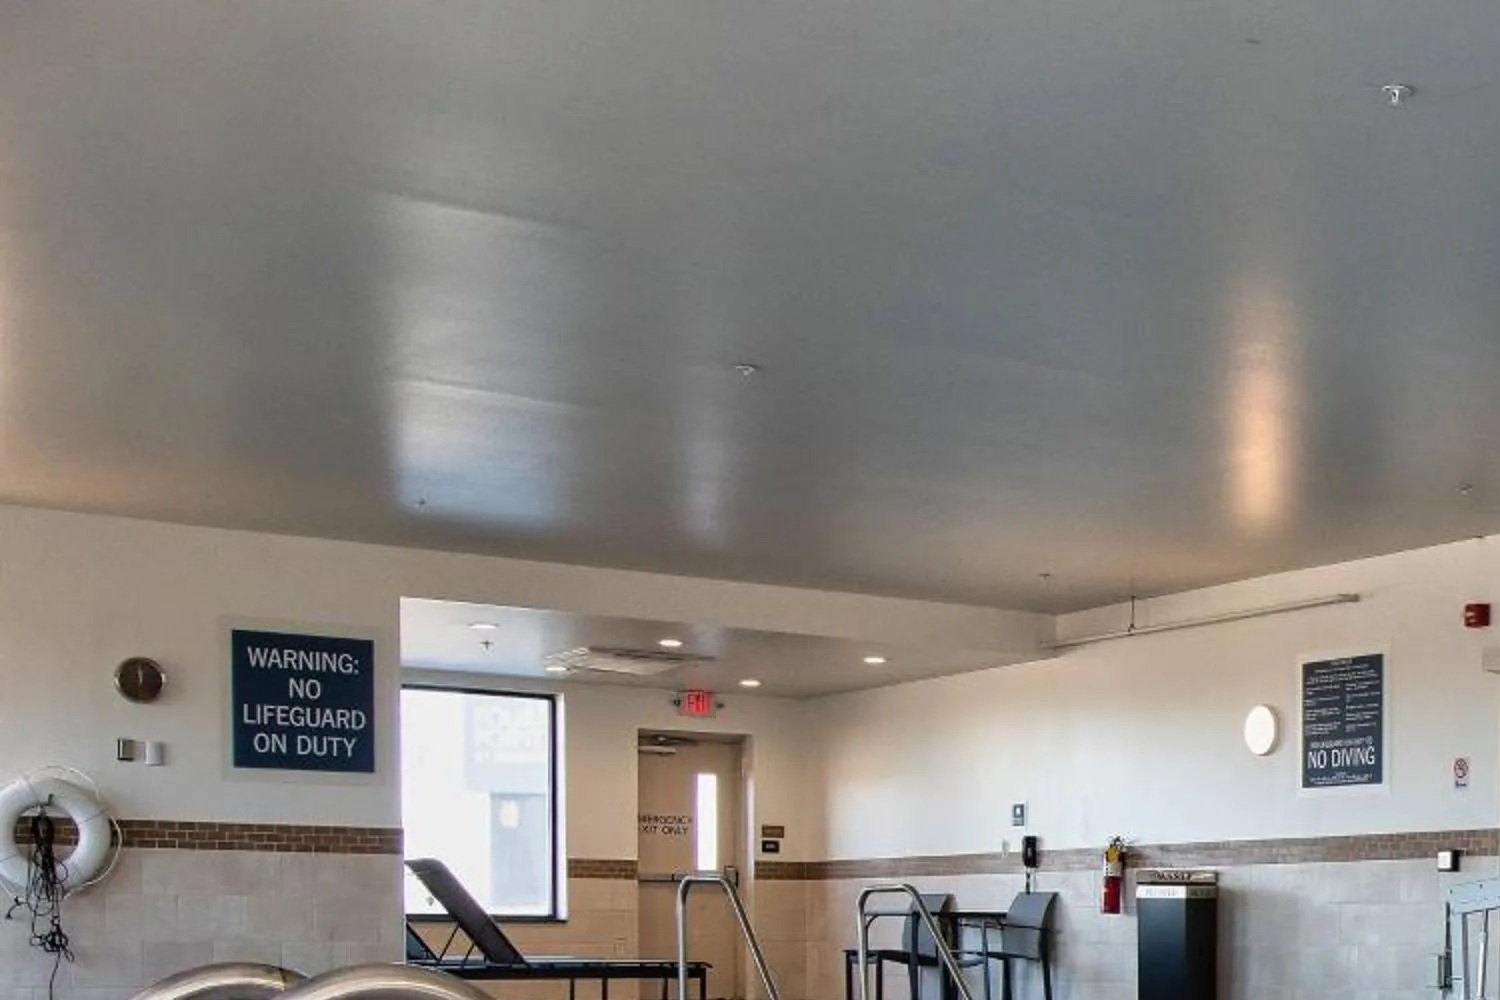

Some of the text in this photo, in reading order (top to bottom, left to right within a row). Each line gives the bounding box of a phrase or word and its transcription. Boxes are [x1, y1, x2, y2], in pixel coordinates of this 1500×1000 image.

[247, 645, 360, 675] WARNING:
[288, 677, 322, 700] NO
[243, 703, 366, 730] LIFEGUARD
[253, 733, 357, 757] ON DUTY
[1308, 746, 1375, 769] NO DIVING
